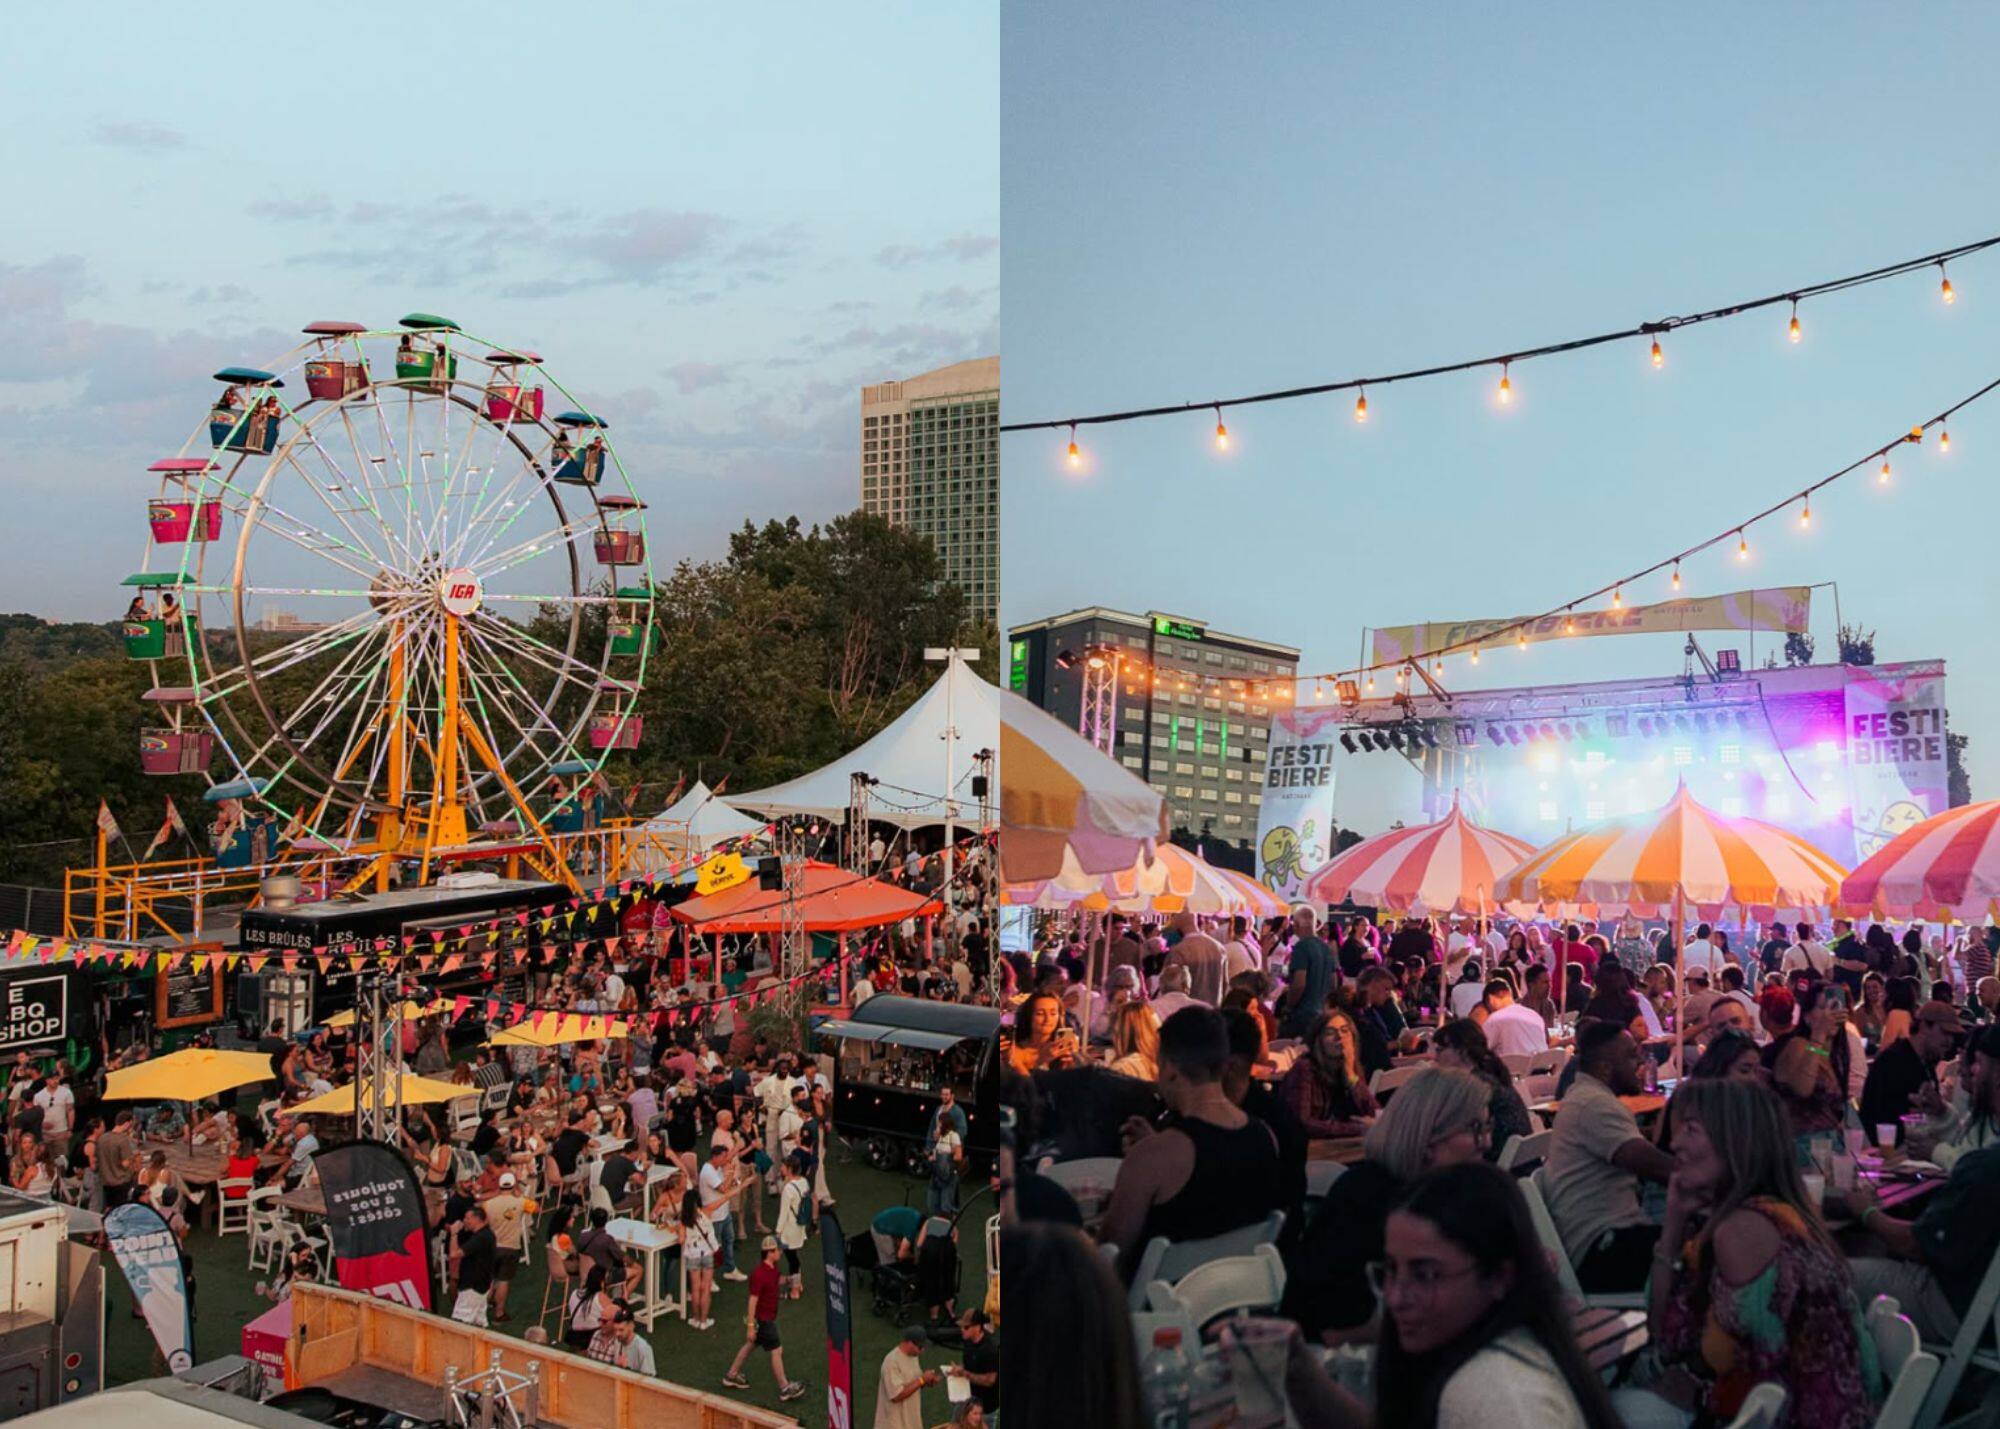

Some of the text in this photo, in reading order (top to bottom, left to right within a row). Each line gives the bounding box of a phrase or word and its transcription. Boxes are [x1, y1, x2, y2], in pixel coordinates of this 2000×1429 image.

[449, 584, 476, 599] IGA
[1853, 708, 1940, 738] FESTI
[1270, 743, 1334, 767] FESTI
[1854, 736, 1941, 765] BIERE
[1267, 766, 1331, 788] BIERE
[245, 929, 266, 943] LES
[327, 930, 354, 944] LES
